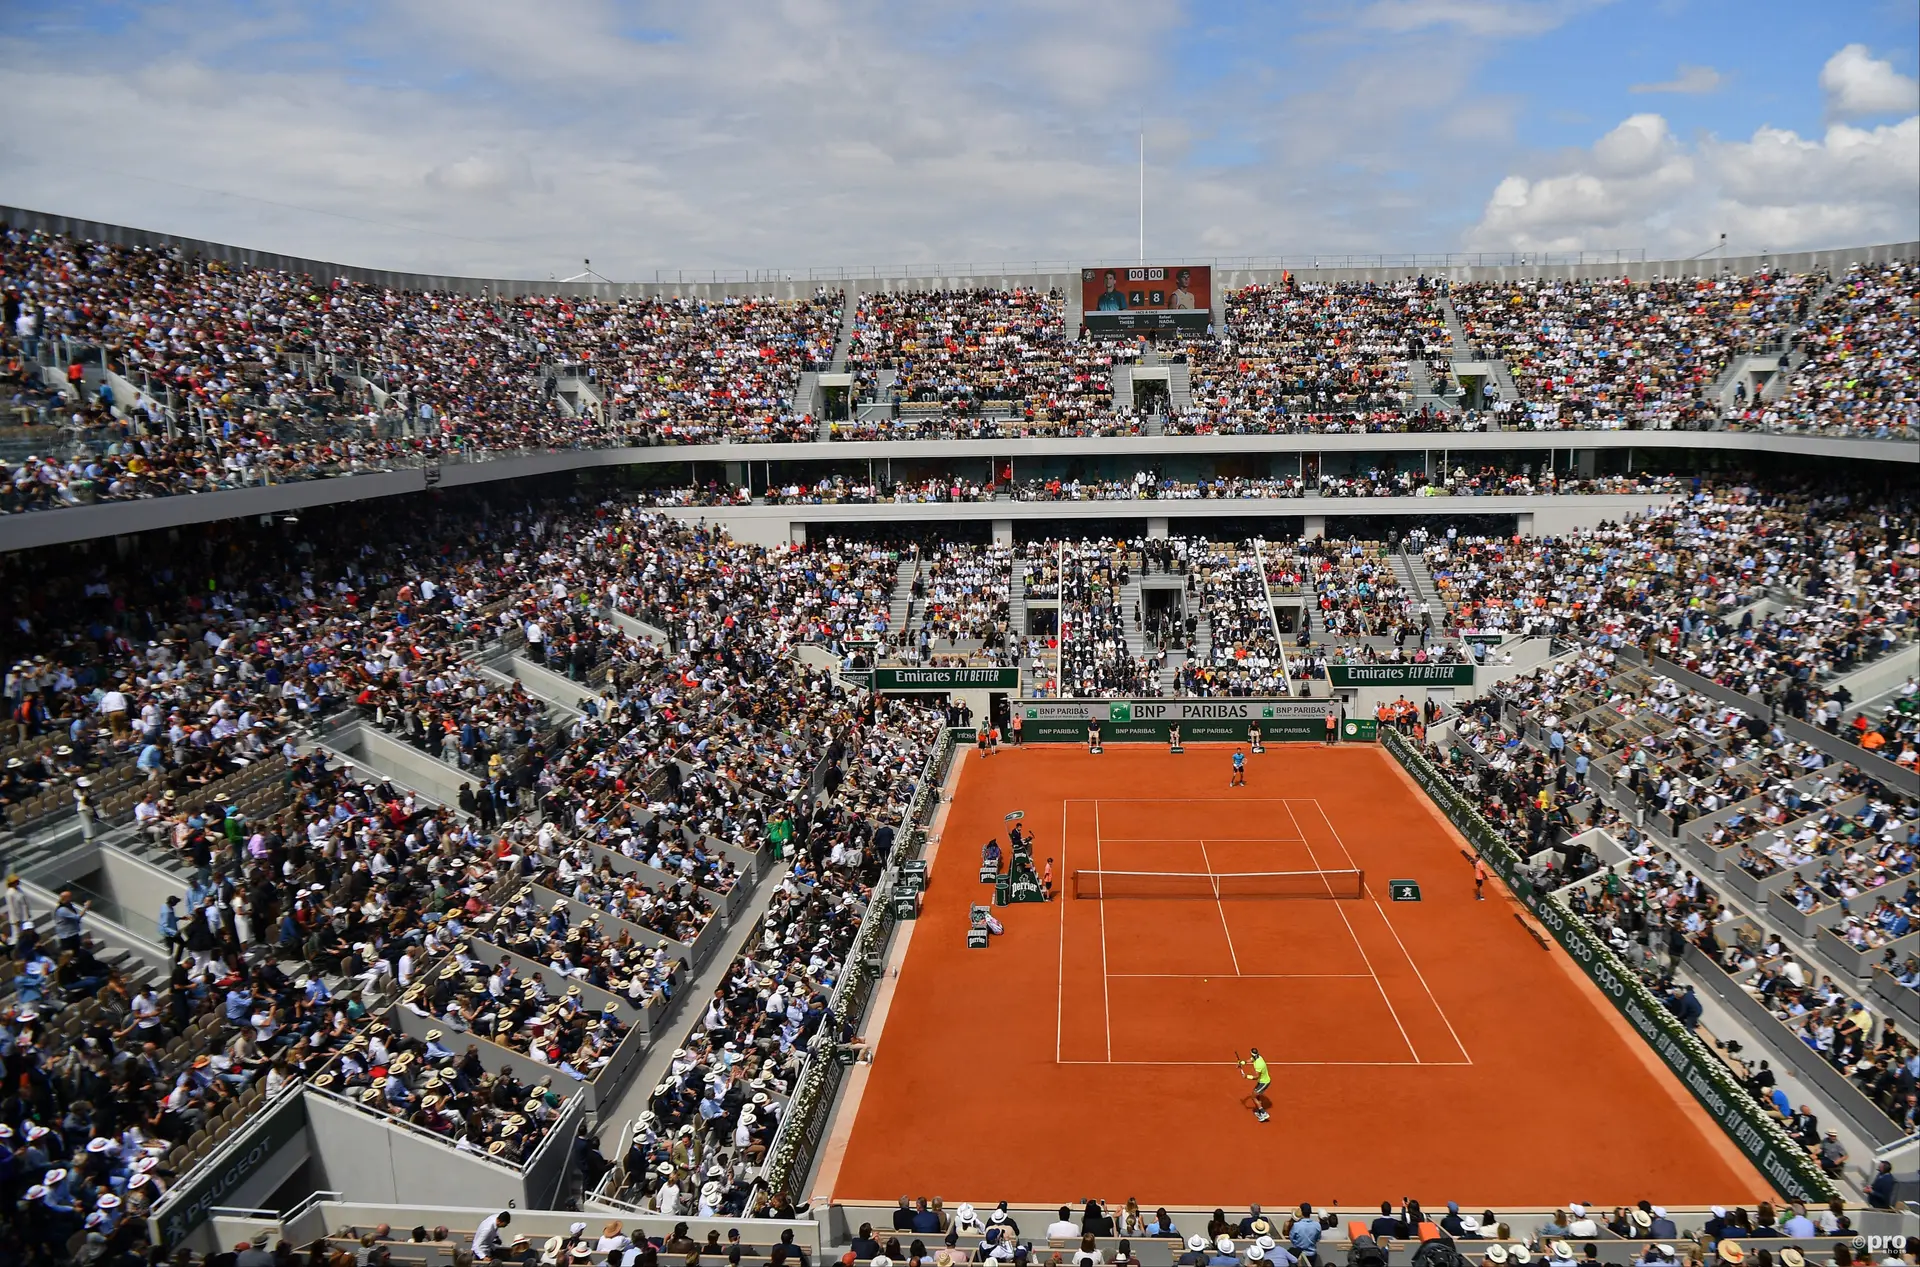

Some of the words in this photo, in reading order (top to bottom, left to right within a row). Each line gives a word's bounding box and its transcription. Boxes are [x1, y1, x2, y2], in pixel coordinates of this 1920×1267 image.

[1130, 270, 1162, 279] 00:00
[1133, 293, 1140, 303] 4
[1153, 292, 1160, 303] 8
[895, 670, 951, 682] Emirates
[955, 670, 969, 682] FLY
[970, 670, 999, 682] BETTER
[1348, 667, 1404, 679] Emirates
[1408, 666, 1424, 678] FLY
[1424, 666, 1454, 678] BETTER
[1134, 705, 1166, 718] BNP
[1182, 704, 1248, 718] PARIBAS
[1409, 762, 1428, 784] PEUGEOT
[1431, 785, 1452, 810] PEUGEOT
[1565, 930, 1592, 962] oppo
[1594, 962, 1624, 997] oppo
[1625, 997, 1659, 1040] Emirates
[1664, 1042, 1690, 1073] BETTER
[1686, 1064, 1727, 1116] Emirates
[1724, 1109, 1743, 1130] FLY
[1736, 1121, 1765, 1157] BETTER
[806, 1096, 828, 1146] Emirates
[187, 1136, 271, 1223] PEUGEOT
[508, 1199, 516, 1209] 6
